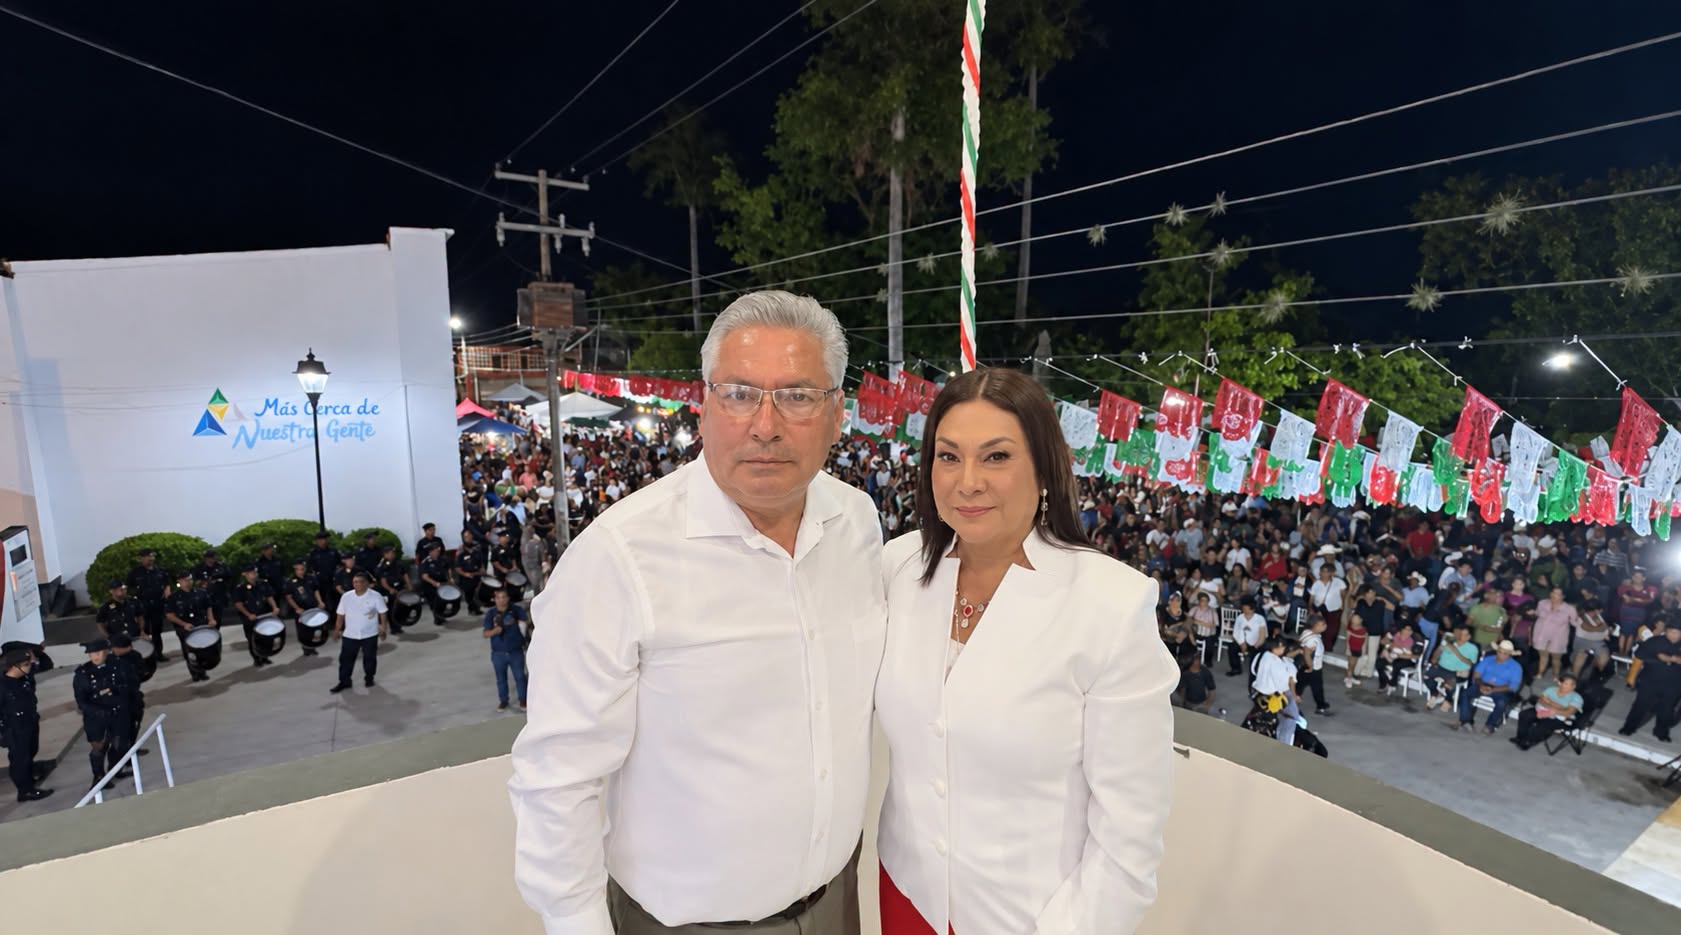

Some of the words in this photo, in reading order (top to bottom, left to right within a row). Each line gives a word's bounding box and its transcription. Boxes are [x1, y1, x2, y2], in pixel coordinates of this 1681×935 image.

[254, 398, 298, 416] Más
[304, 401, 352, 416] Cerca
[357, 398, 380, 416] de
[232, 419, 317, 449] Nuestra
[326, 419, 376, 442] Gente
